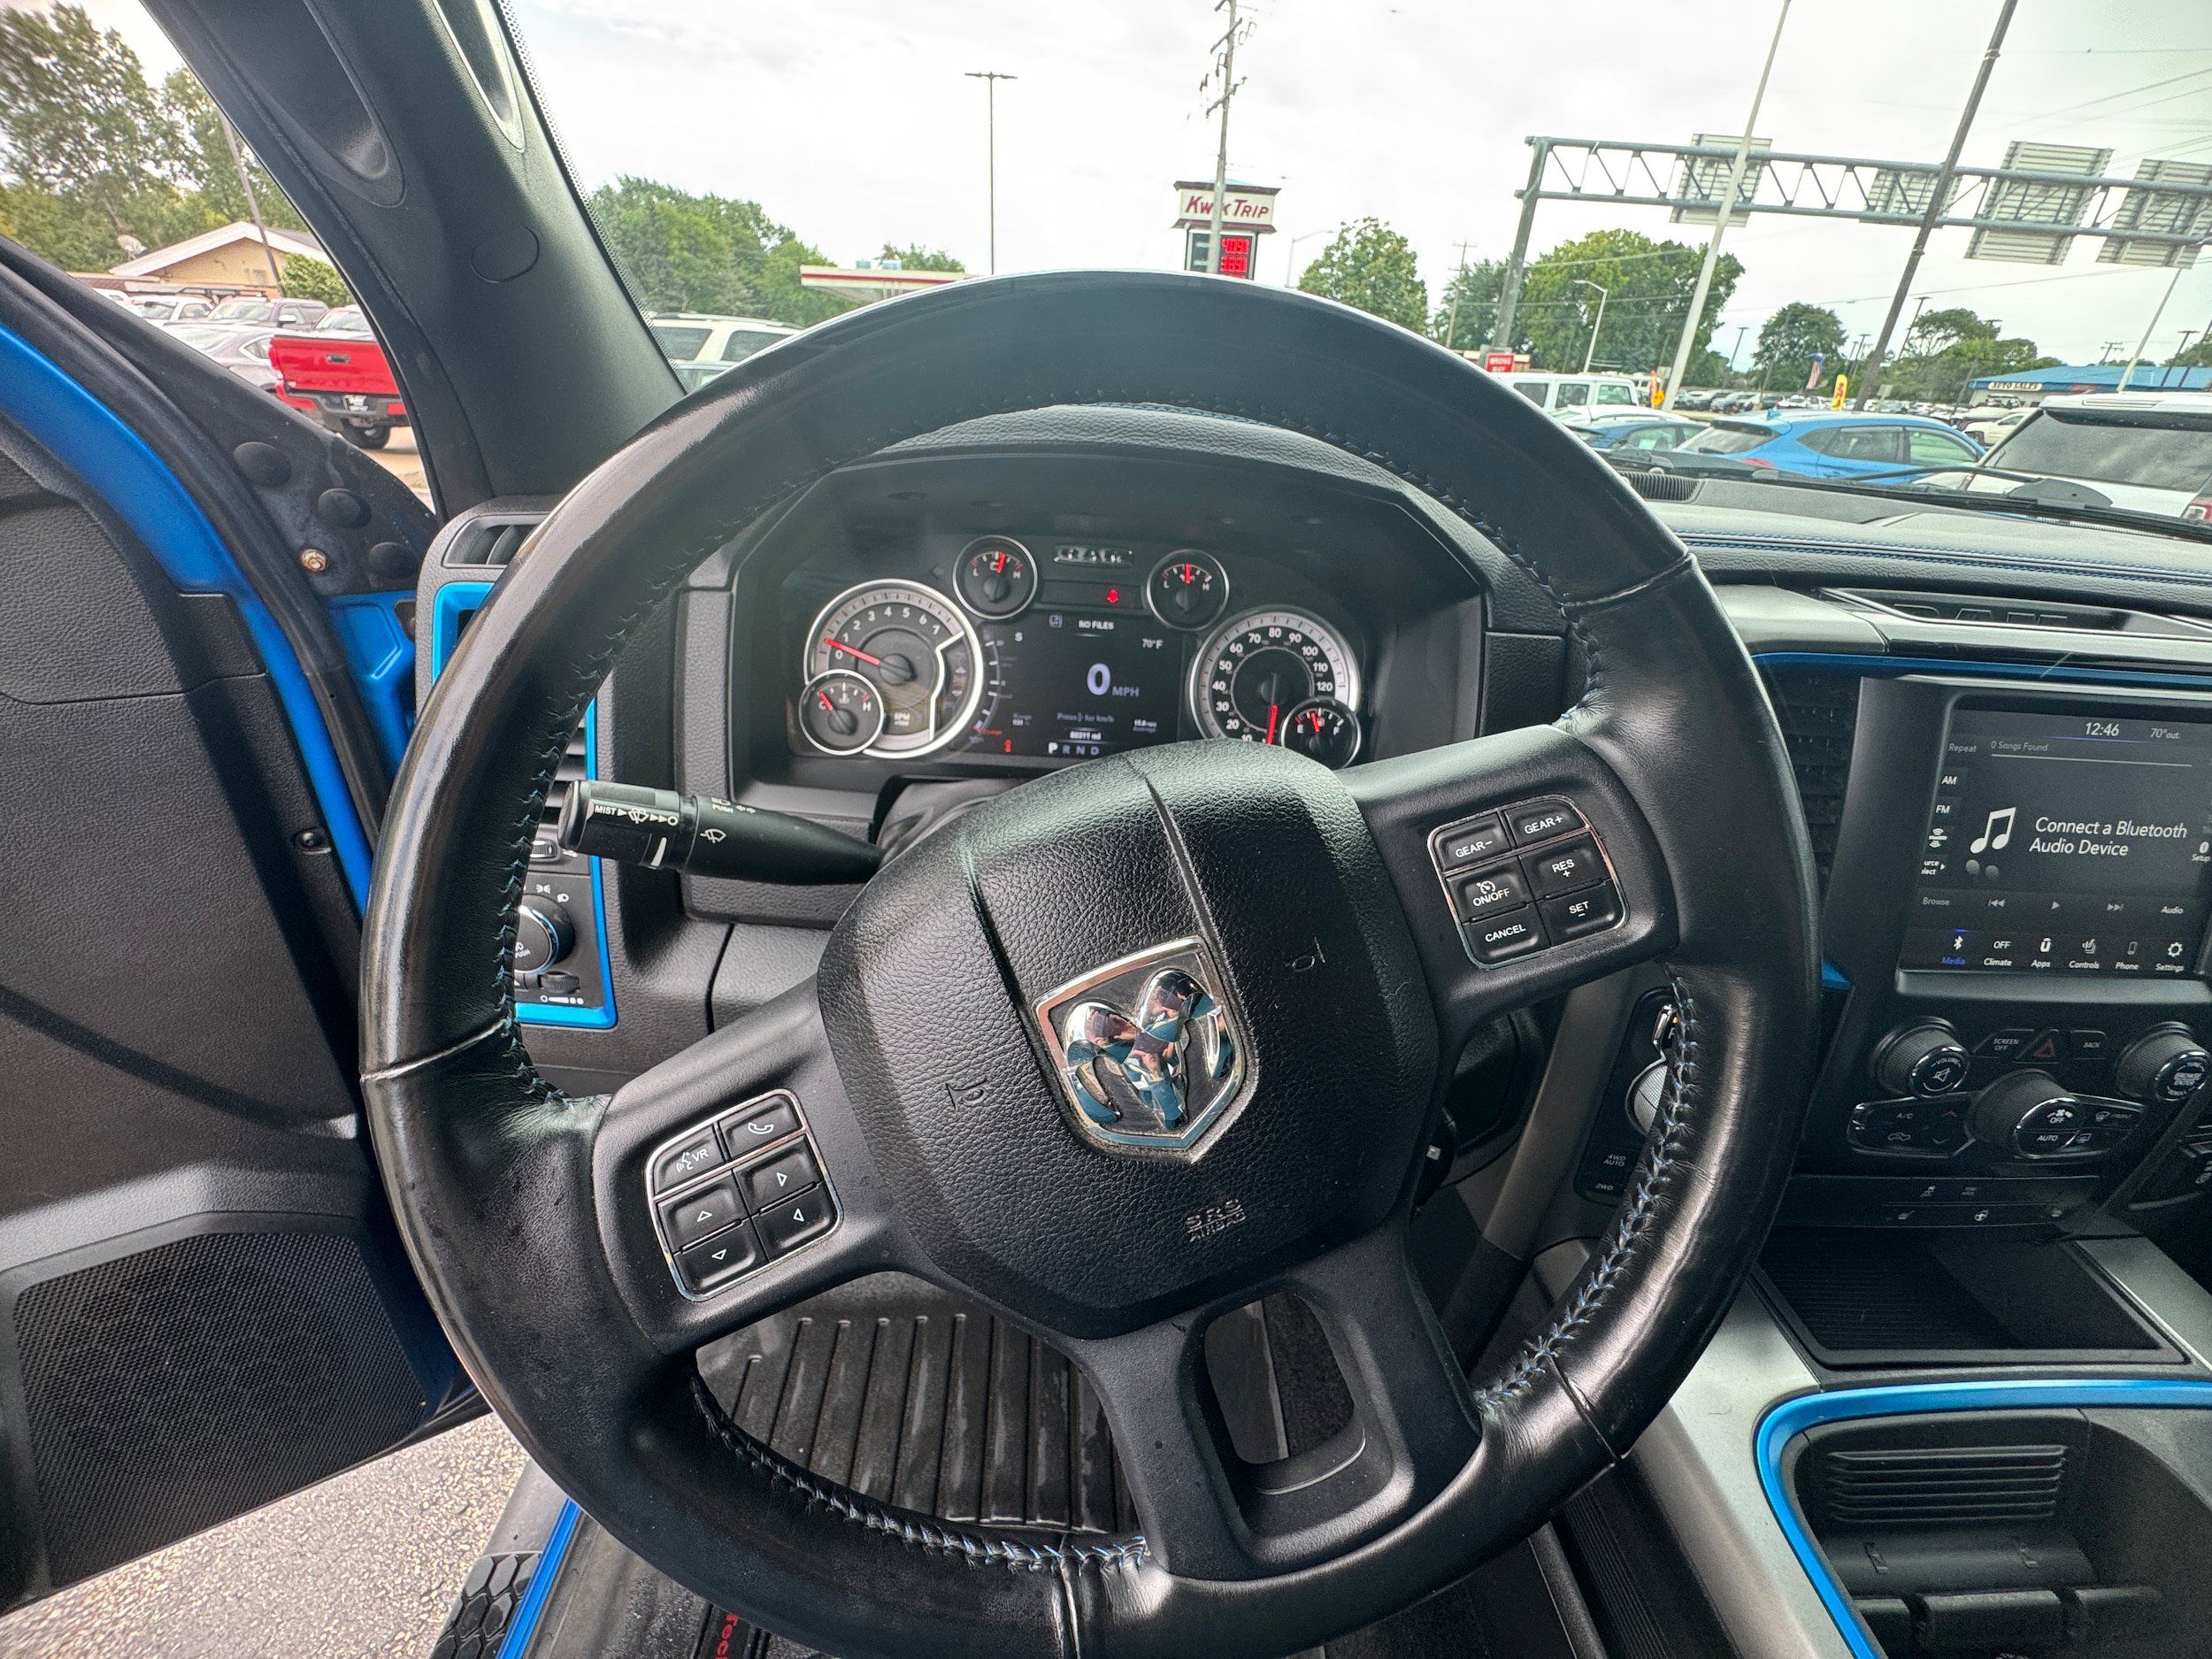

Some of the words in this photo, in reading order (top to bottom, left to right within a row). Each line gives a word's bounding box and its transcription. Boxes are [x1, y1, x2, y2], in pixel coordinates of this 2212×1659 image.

[1186, 196, 1232, 216] KWK
[868, 611, 876, 621] 3
[884, 606, 892, 617] 4
[902, 608, 910, 618] 5
[919, 614, 927, 625] 6
[1079, 619, 1091, 629] NO
[1092, 620, 1115, 630] FILES
[853, 620, 861, 631] 2
[933, 625, 941, 635] 7
[842, 633, 849, 642] 1
[1268, 627, 1282, 638] 80
[1248, 633, 1262, 644] 70
[1288, 633, 1302, 644] 90
[1229, 642, 1243, 654] 60
[1302, 646, 1318, 657] 100
[835, 649, 843, 659] 0
[1219, 660, 1233, 671] 50
[1313, 663, 1328, 672] 110
[1087, 663, 1111, 695] 0
[1112, 686, 1140, 697] MPH
[1212, 680, 1226, 692] 40
[1316, 681, 1333, 692] 120
[863, 702, 872, 711] H
[1216, 702, 1230, 711] 30
[1226, 718, 1240, 730] 20
[2085, 722, 2120, 737] 12:46
[1333, 726, 1340, 735] F
[1241, 733, 1253, 742] 10
[1048, 741, 1058, 754] P
[1076, 745, 1086, 755] N
[1090, 746, 1100, 756] D
[1948, 743, 1977, 754] Repeat
[1991, 741, 1997, 749] 0
[1998, 741, 2022, 752] Songs
[2023, 743, 2049, 752] Found
[1941, 776, 1957, 785] AM
[594, 804, 618, 815] MIST
[1936, 805, 1950, 814] FM
[2036, 817, 2099, 834] Connect
[2103, 825, 2112, 835] a
[2116, 821, 2187, 838] Bluetooth
[2029, 838, 2075, 855] Audio
[2078, 840, 2129, 856] Device
[1551, 858, 1575, 873] RES
[1472, 887, 1510, 908] ON/OFF
[1922, 896, 1950, 907] Browse
[1569, 901, 1590, 915] SET
[2162, 905, 2184, 915] Audio
[1485, 924, 1526, 942] CANCEL
[1993, 941, 2012, 949] OFF
[1941, 956, 1966, 965] Media
[1984, 957, 2013, 967] Climate
[2031, 959, 2051, 970] Apps
[2069, 960, 2100, 970] Controls
[2115, 961, 2139, 971] Phone
[2155, 963, 2185, 973] Settings
[1935, 1057, 1961, 1067] VOLUME
[692, 1148, 710, 1164] VR
[1603, 1158, 1625, 1167] AUTO
[1186, 1198, 1241, 1230] SRS
